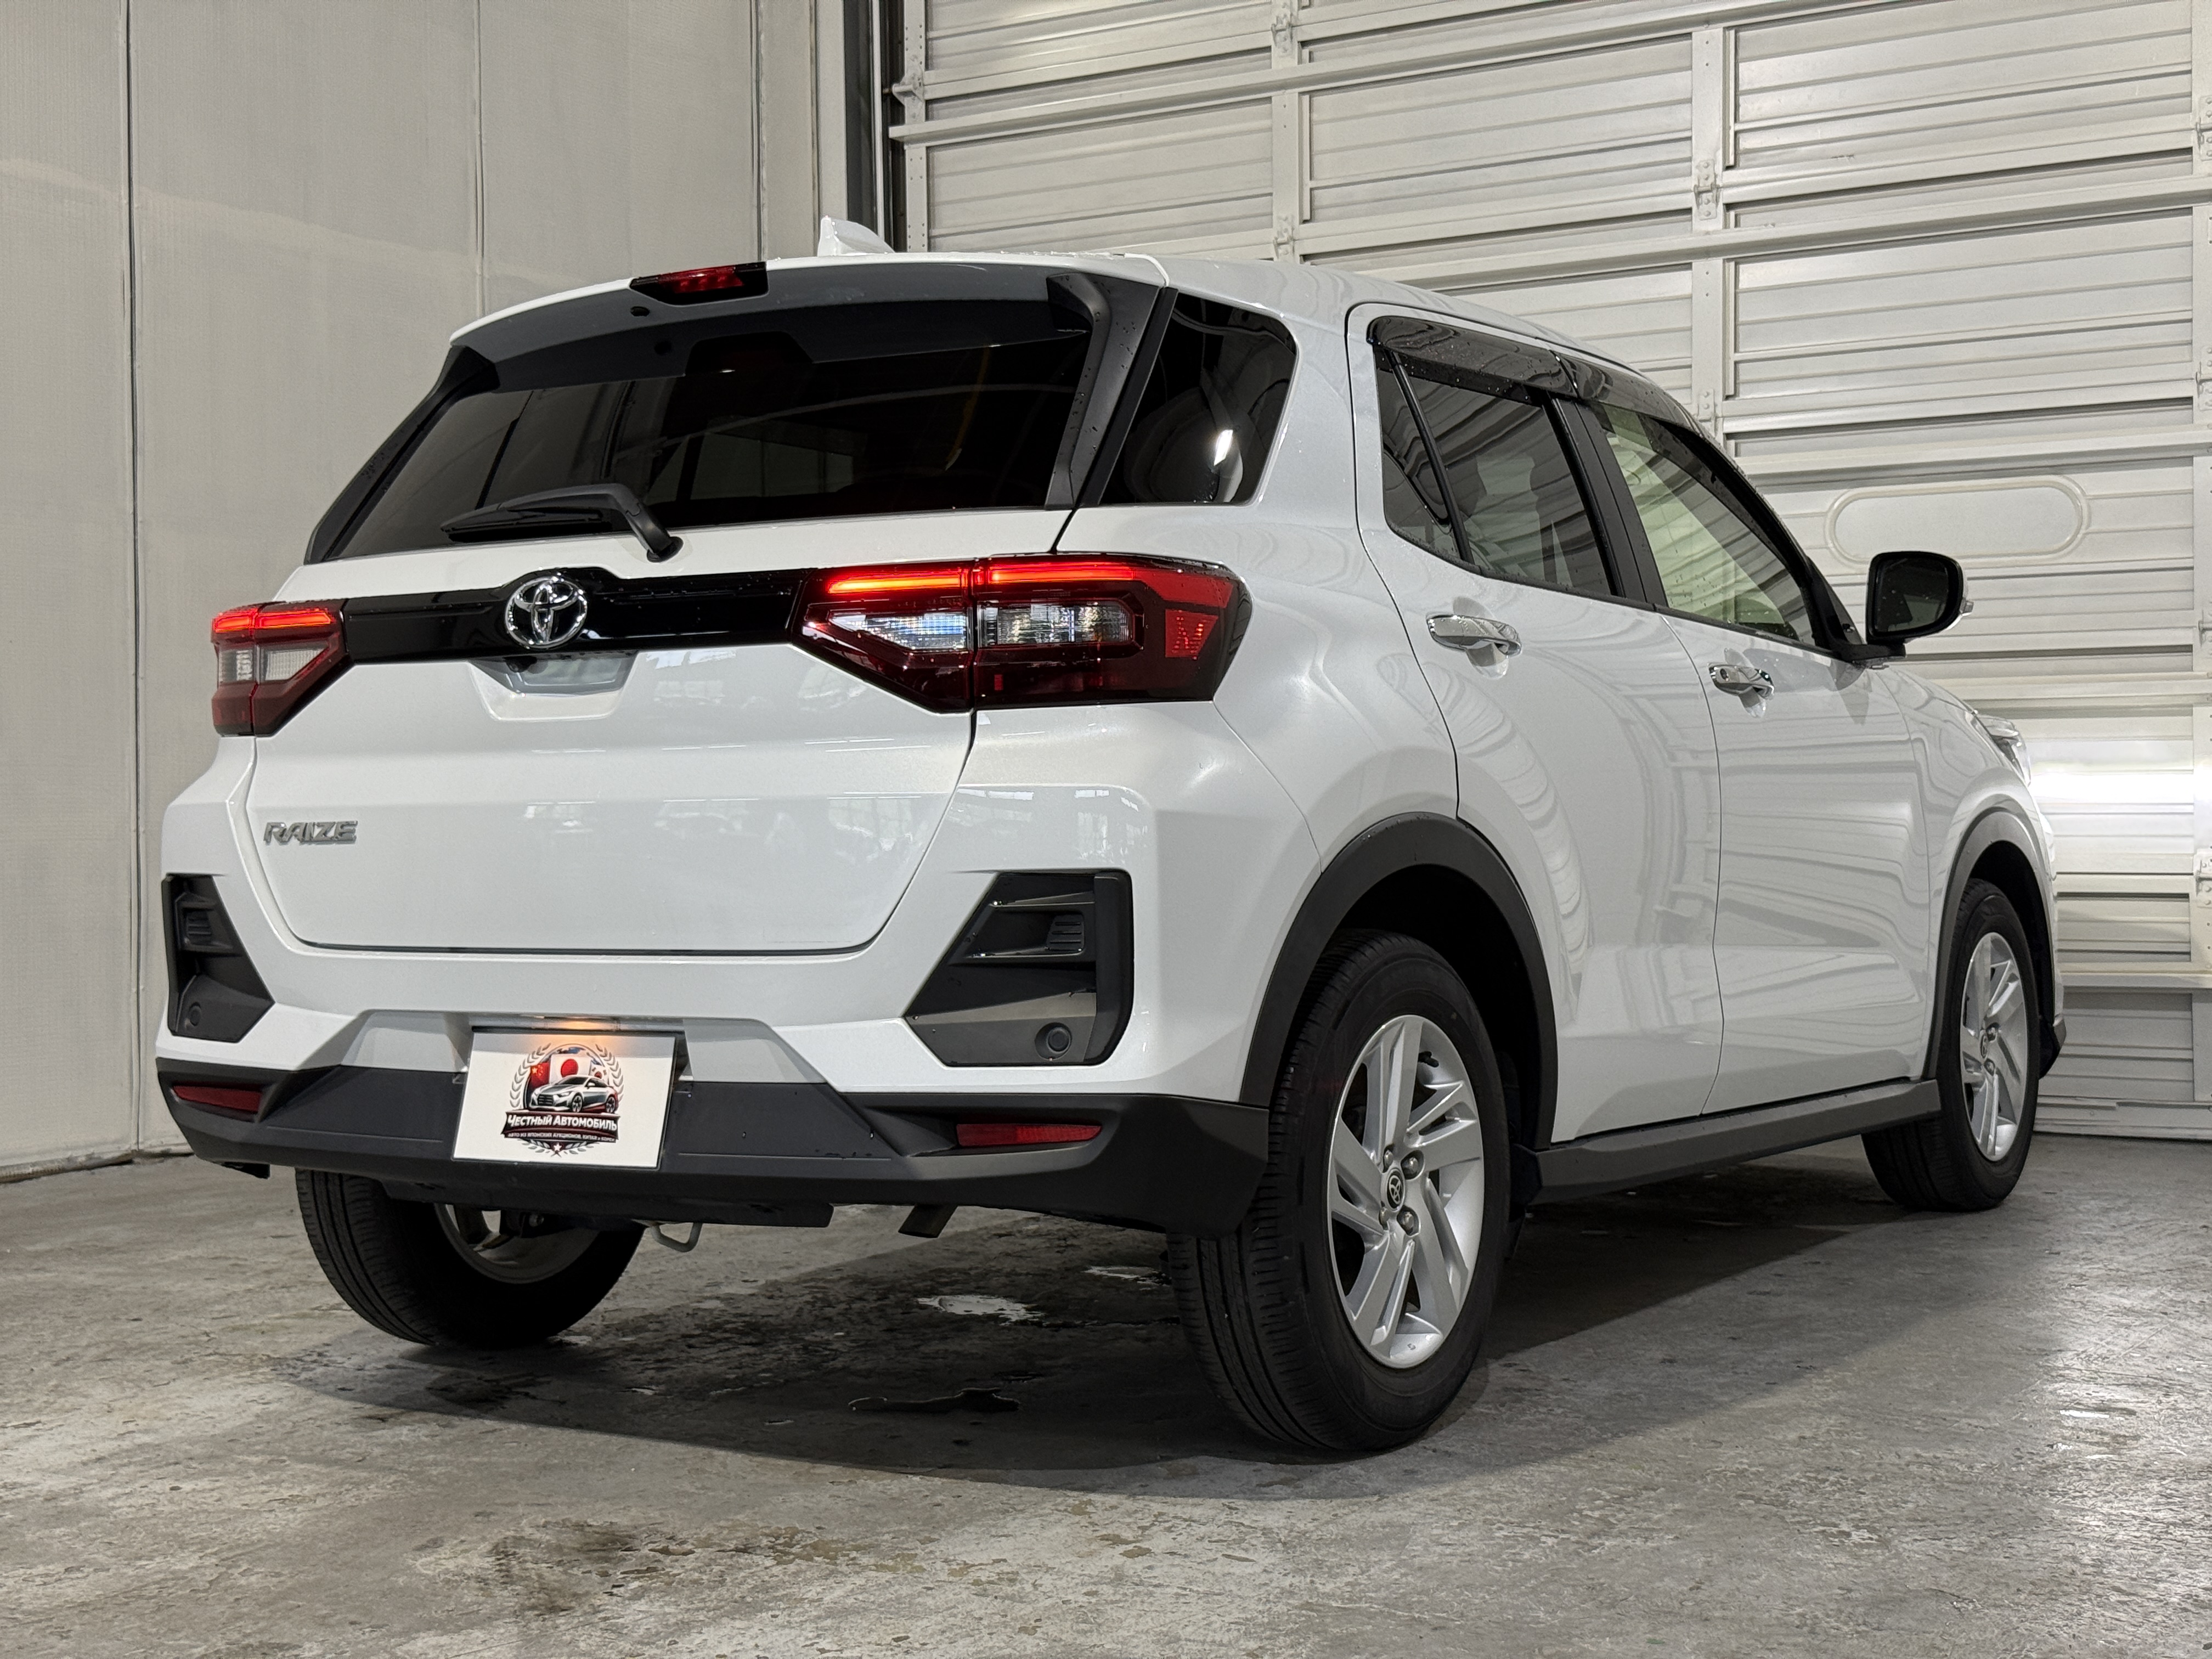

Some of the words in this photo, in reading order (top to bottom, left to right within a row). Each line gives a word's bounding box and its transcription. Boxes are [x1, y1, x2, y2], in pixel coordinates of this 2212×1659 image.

[264, 821, 358, 845] RAIZE
[507, 1114, 553, 1127] ЧЕСТНЫЙ
[552, 1115, 617, 1131] АВТОМОБИЛЬ
